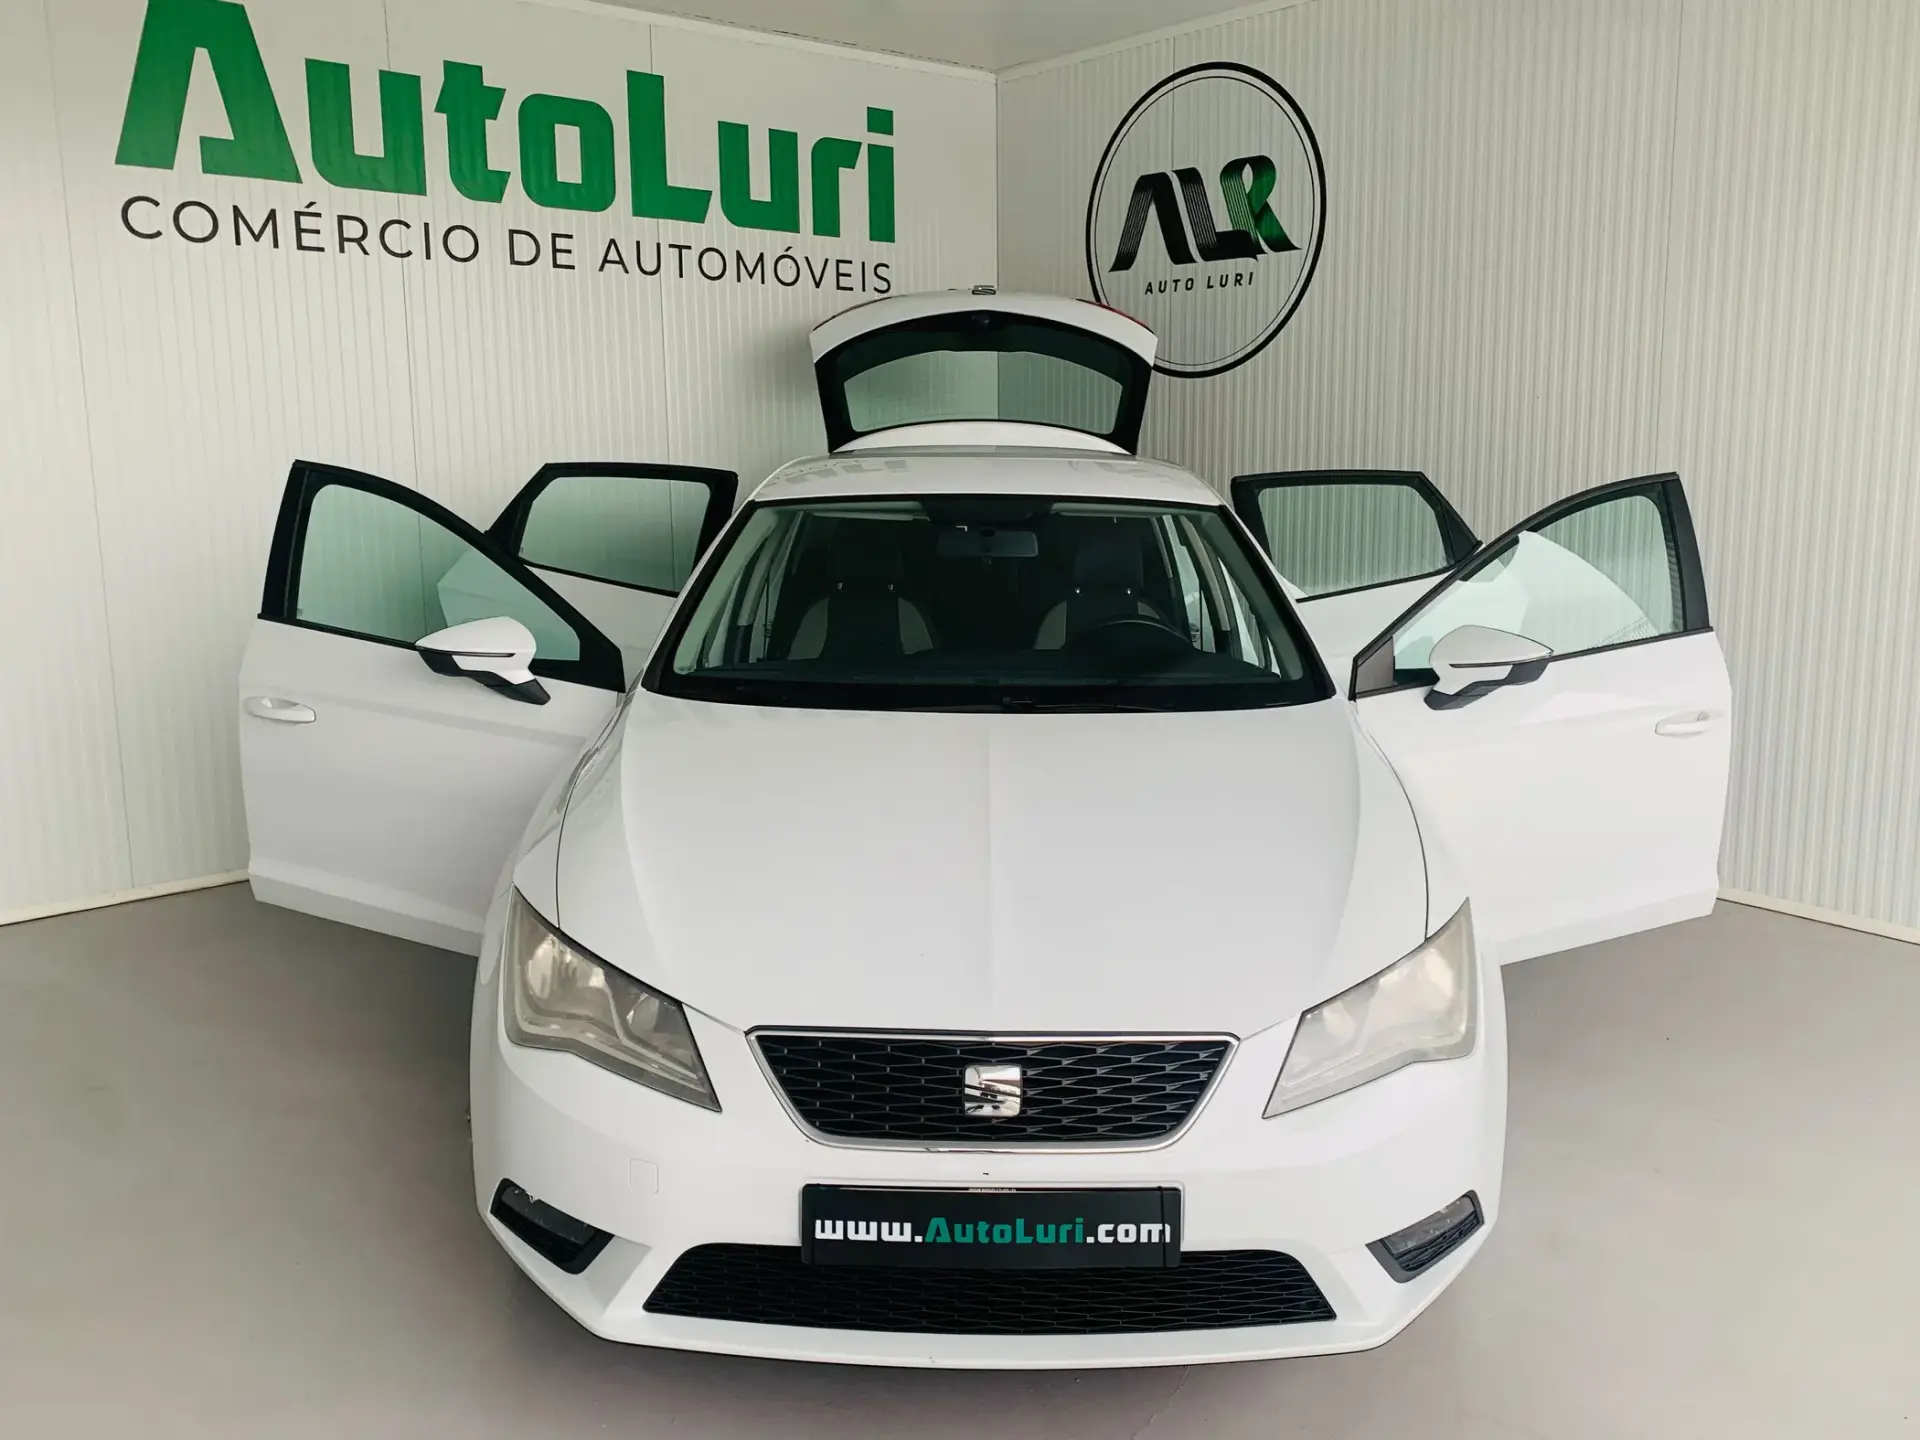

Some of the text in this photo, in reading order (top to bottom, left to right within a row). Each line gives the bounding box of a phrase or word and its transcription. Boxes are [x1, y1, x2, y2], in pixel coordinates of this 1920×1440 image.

[115, 0, 896, 243] AutoLuri
[120, 195, 893, 295] COMÉRCIO DE AUTOMÓVEIS
[1144, 271, 1255, 295] AUTO LURI
[814, 1217, 1171, 1244] www.AutoLuri.com
